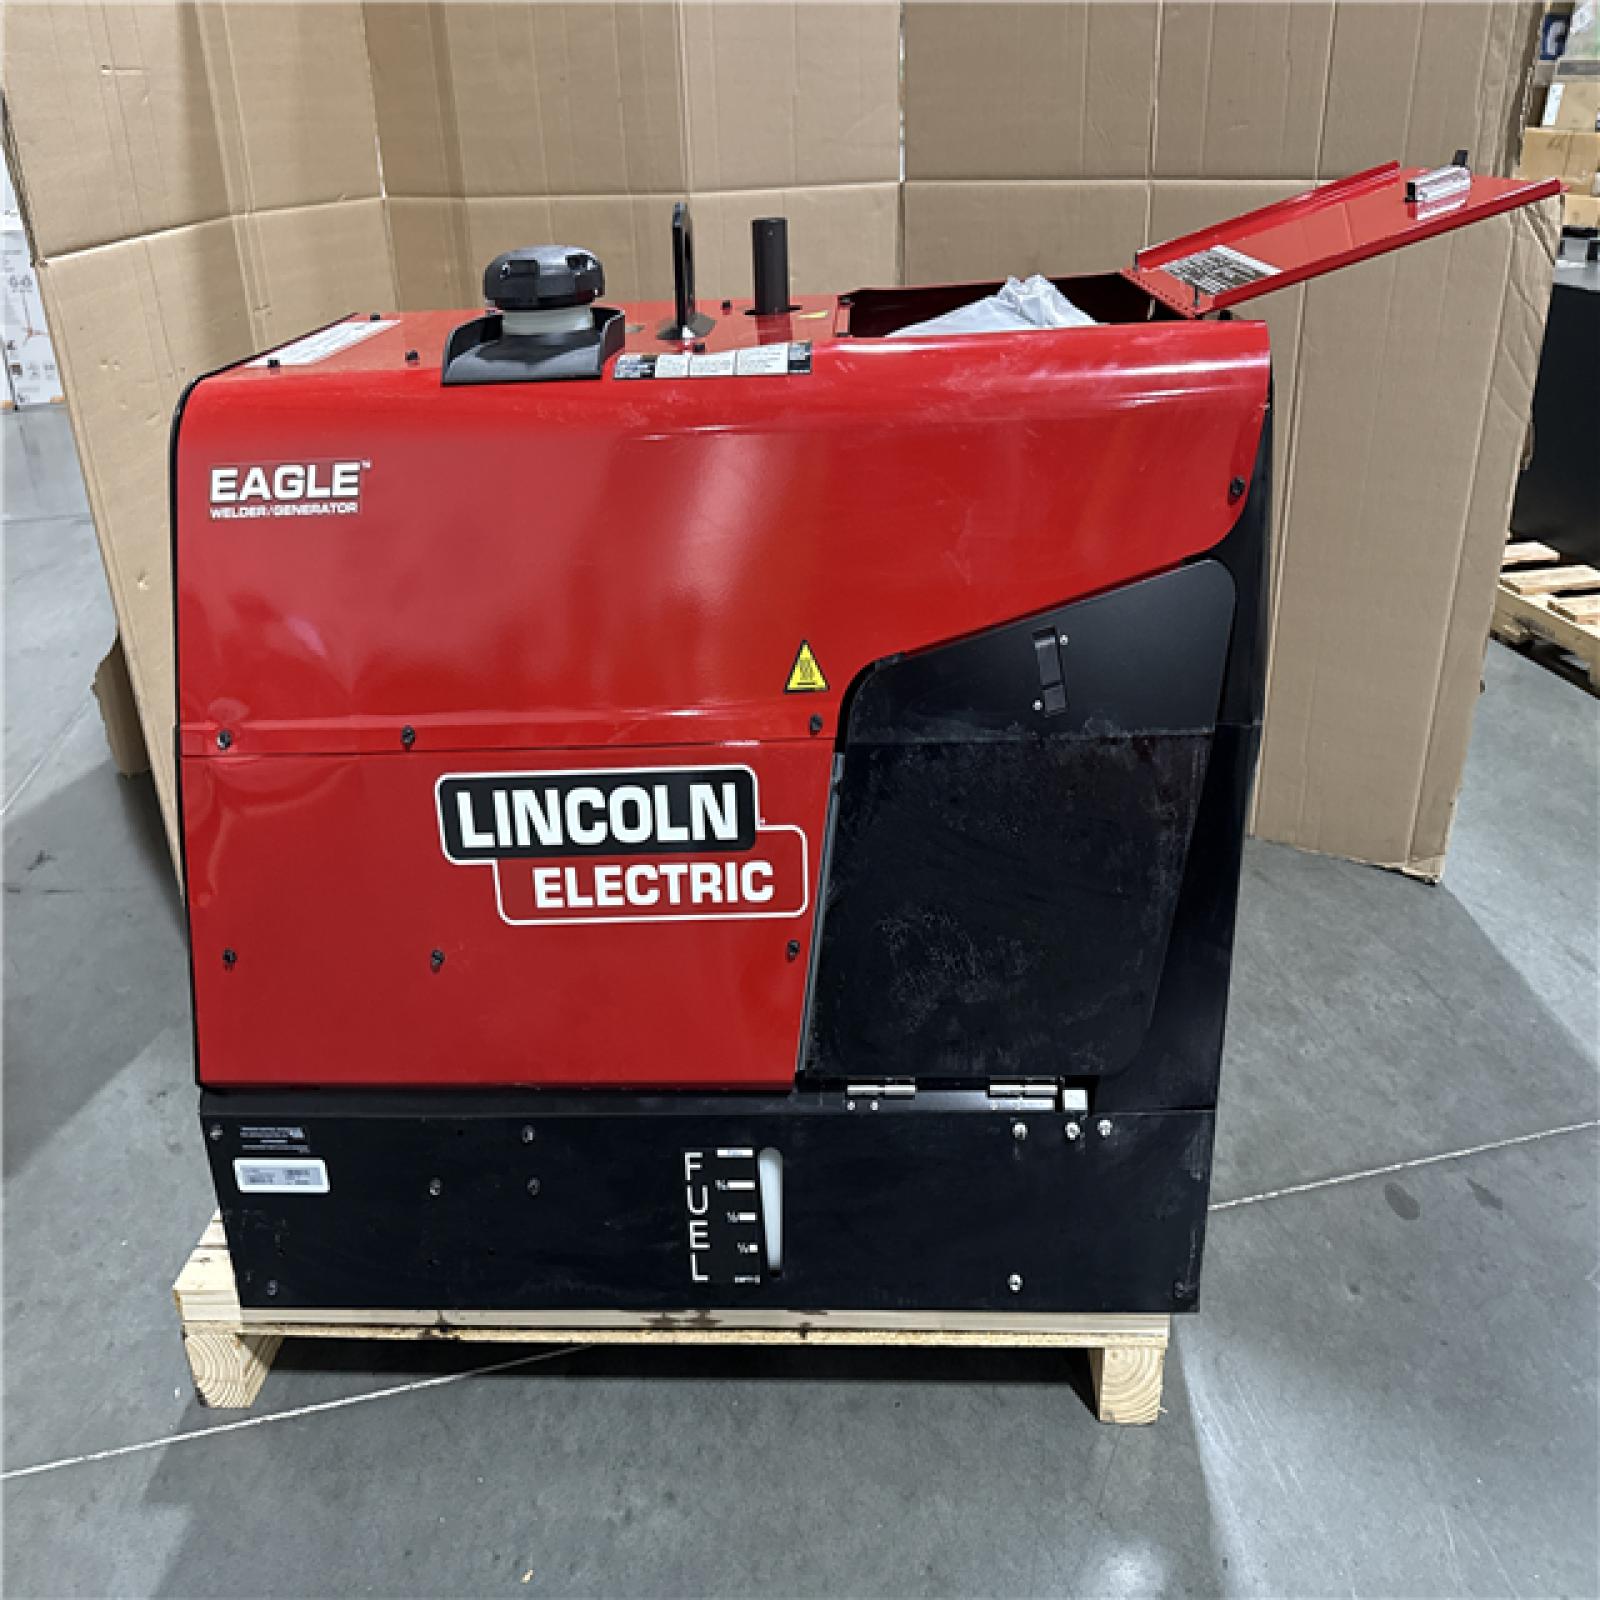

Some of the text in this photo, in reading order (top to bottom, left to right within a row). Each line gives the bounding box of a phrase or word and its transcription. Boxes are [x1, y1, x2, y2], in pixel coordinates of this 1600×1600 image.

[211, 464, 360, 502] EAGLE
[456, 782, 739, 848] LINCOLN
[532, 860, 774, 908] ELECTRIC
[684, 1151, 710, 1282] FUEL
